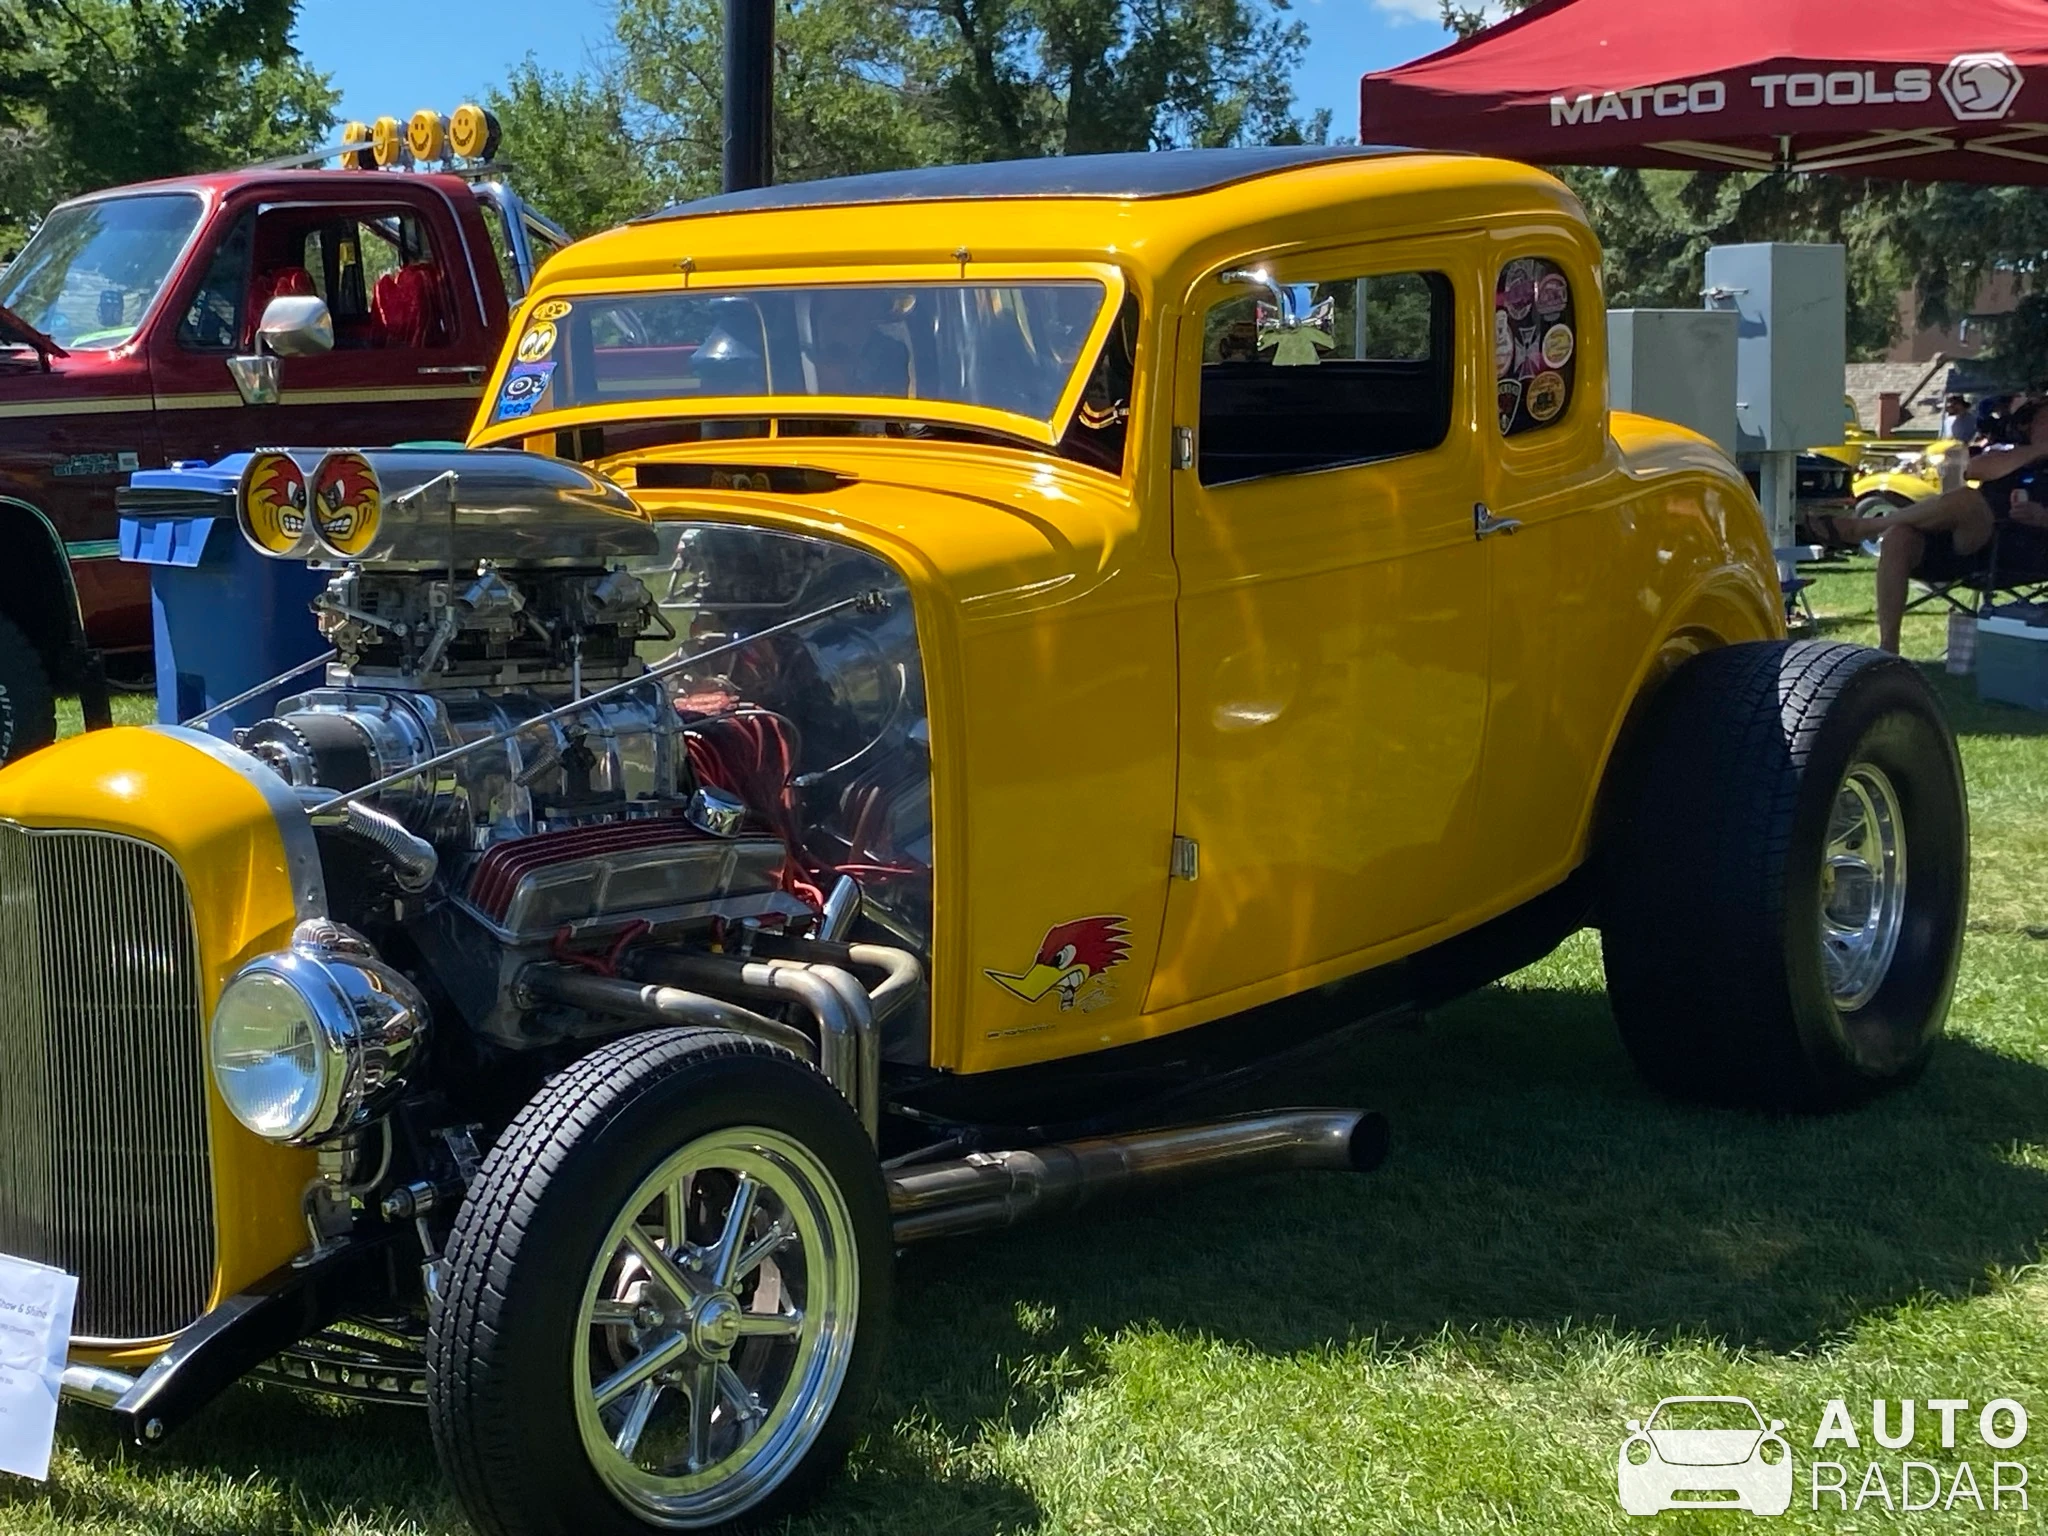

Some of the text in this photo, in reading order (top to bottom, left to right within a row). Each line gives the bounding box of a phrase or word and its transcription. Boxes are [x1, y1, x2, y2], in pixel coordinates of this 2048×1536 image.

[1550, 68, 1932, 127] MATCO TOOLS
[25, 1305, 47, 1319] Shine
